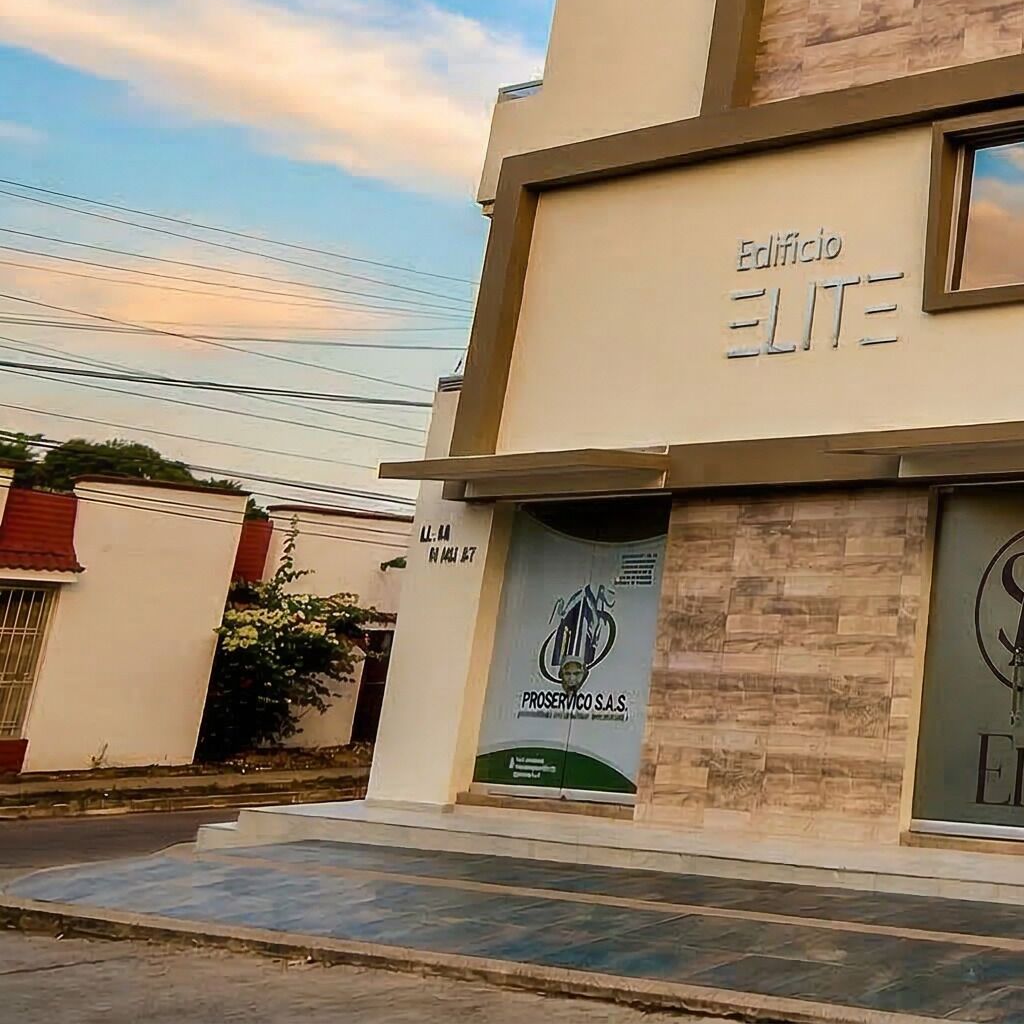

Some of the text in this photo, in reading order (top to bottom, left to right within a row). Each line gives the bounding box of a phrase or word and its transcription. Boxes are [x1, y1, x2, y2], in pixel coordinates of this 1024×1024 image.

[737, 227, 843, 272] Edificio
[726, 272, 904, 358] ELITE
[522, 691, 628, 713] PROSERVICO S.A.S.
